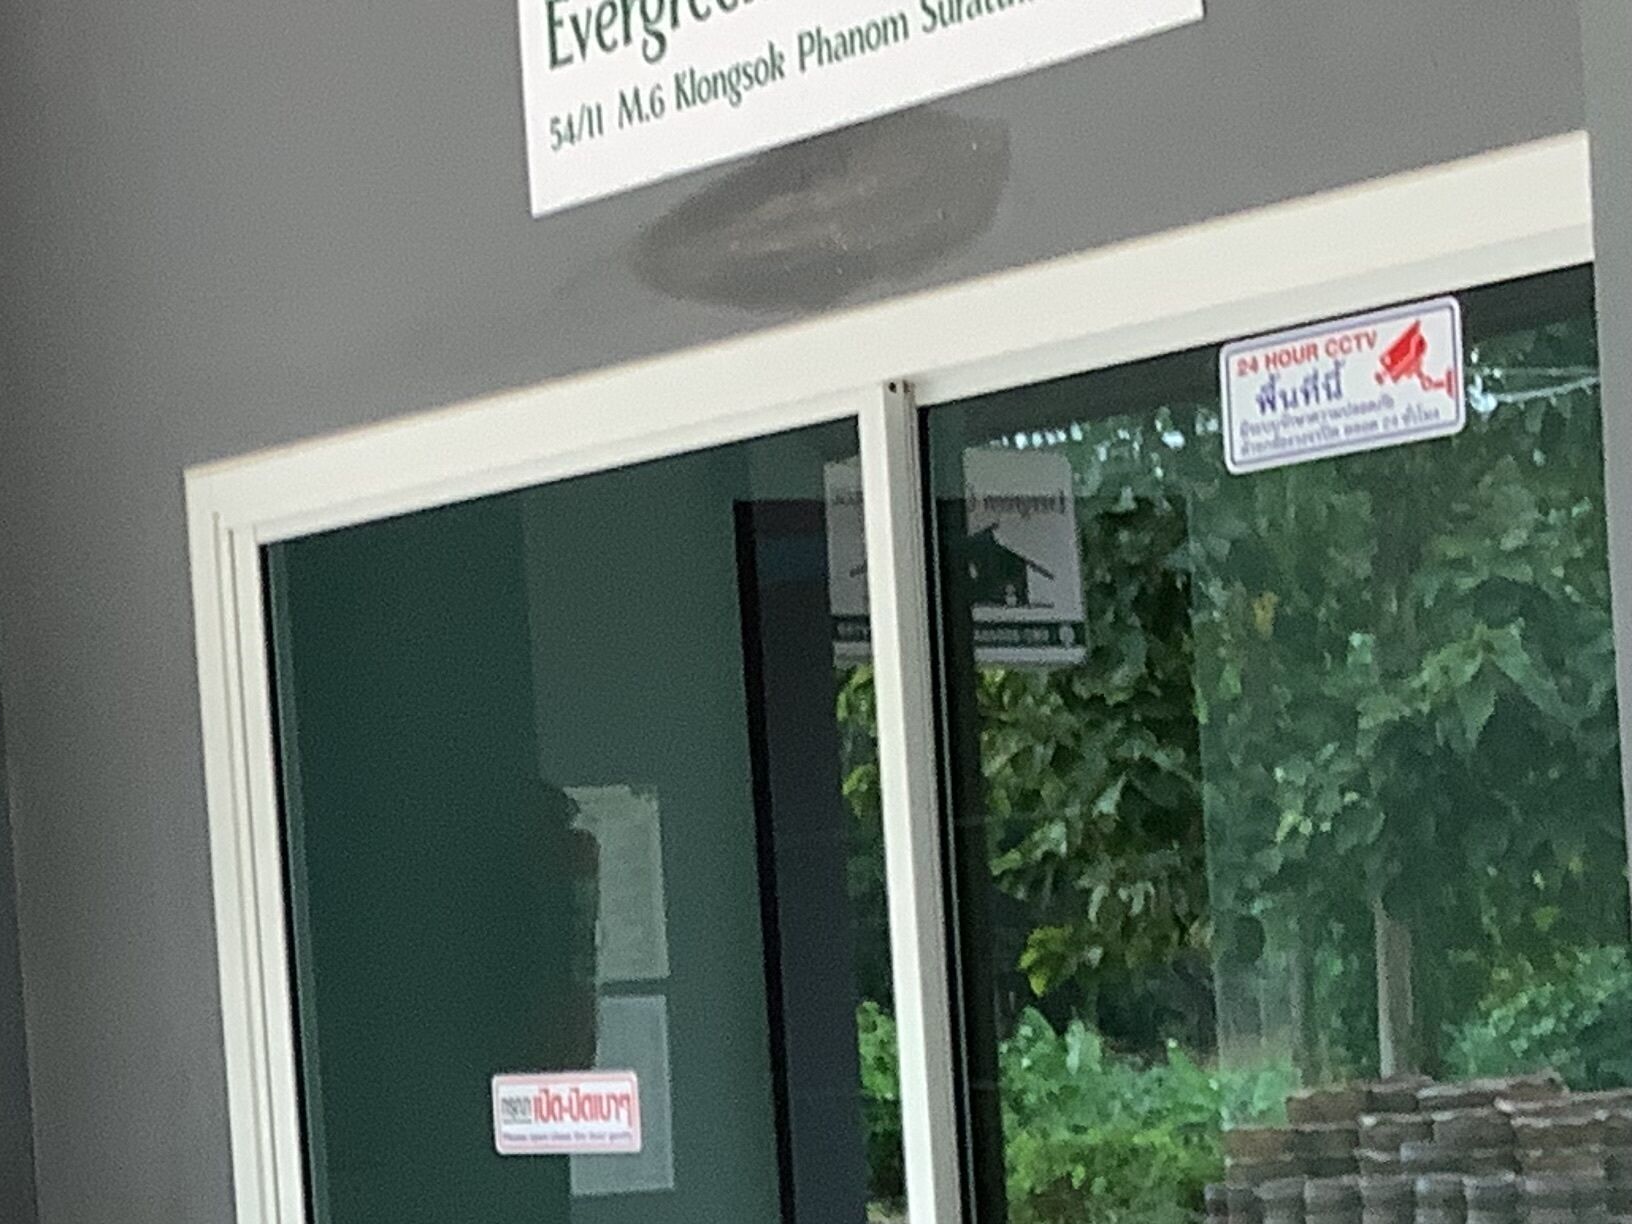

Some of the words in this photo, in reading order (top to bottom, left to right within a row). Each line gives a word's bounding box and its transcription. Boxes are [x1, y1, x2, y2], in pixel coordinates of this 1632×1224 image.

[545, 0, 758, 69] Evergr
[549, 102, 603, 151] 54/11
[618, 84, 665, 129] M.6
[674, 39, 785, 109] Klongsok
[797, 11, 910, 73] Phanom
[1237, 357, 1259, 377] 24
[1265, 342, 1318, 370] HOUR
[1324, 330, 1377, 359] CCTV
